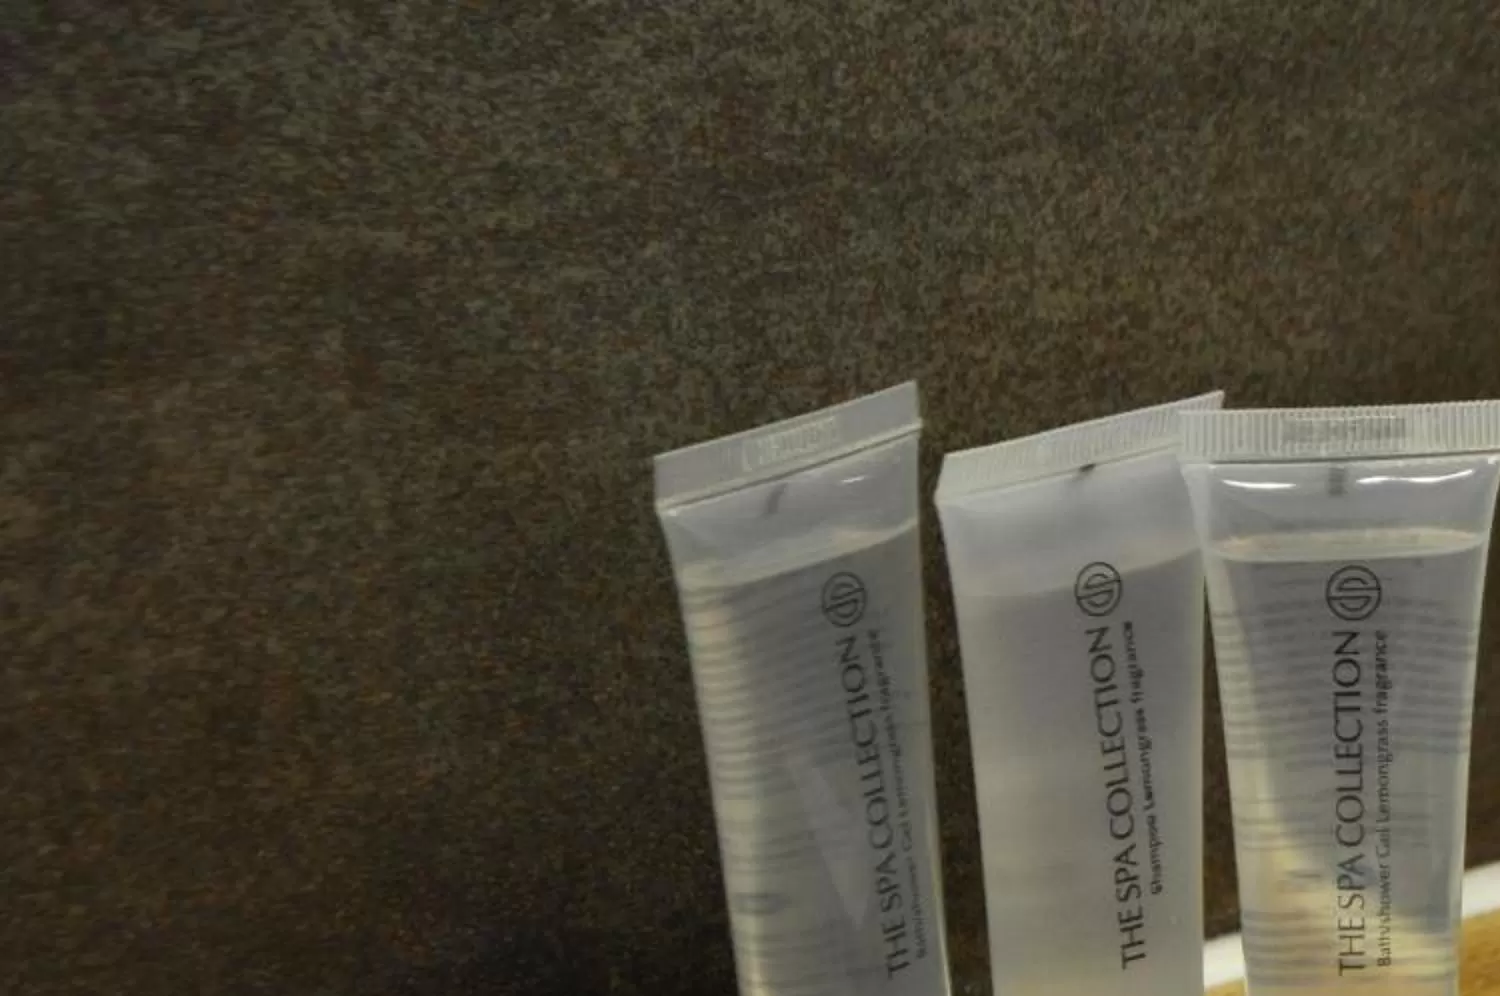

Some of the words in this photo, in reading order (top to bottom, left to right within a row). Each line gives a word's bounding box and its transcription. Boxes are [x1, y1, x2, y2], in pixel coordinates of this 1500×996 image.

[1372, 630, 1393, 714] fragrance
[836, 635, 895, 849] COLLECTION
[1084, 626, 1135, 840] COLLECTION
[1331, 630, 1366, 848] COLLECTION
[875, 853, 904, 913] SPA
[1112, 843, 1142, 900] SPA
[1147, 815, 1164, 895] Shampoo
[1337, 853, 1366, 911] SPA
[880, 919, 910, 980] THE
[1117, 905, 1146, 970] THE
[1338, 917, 1366, 976] THE
